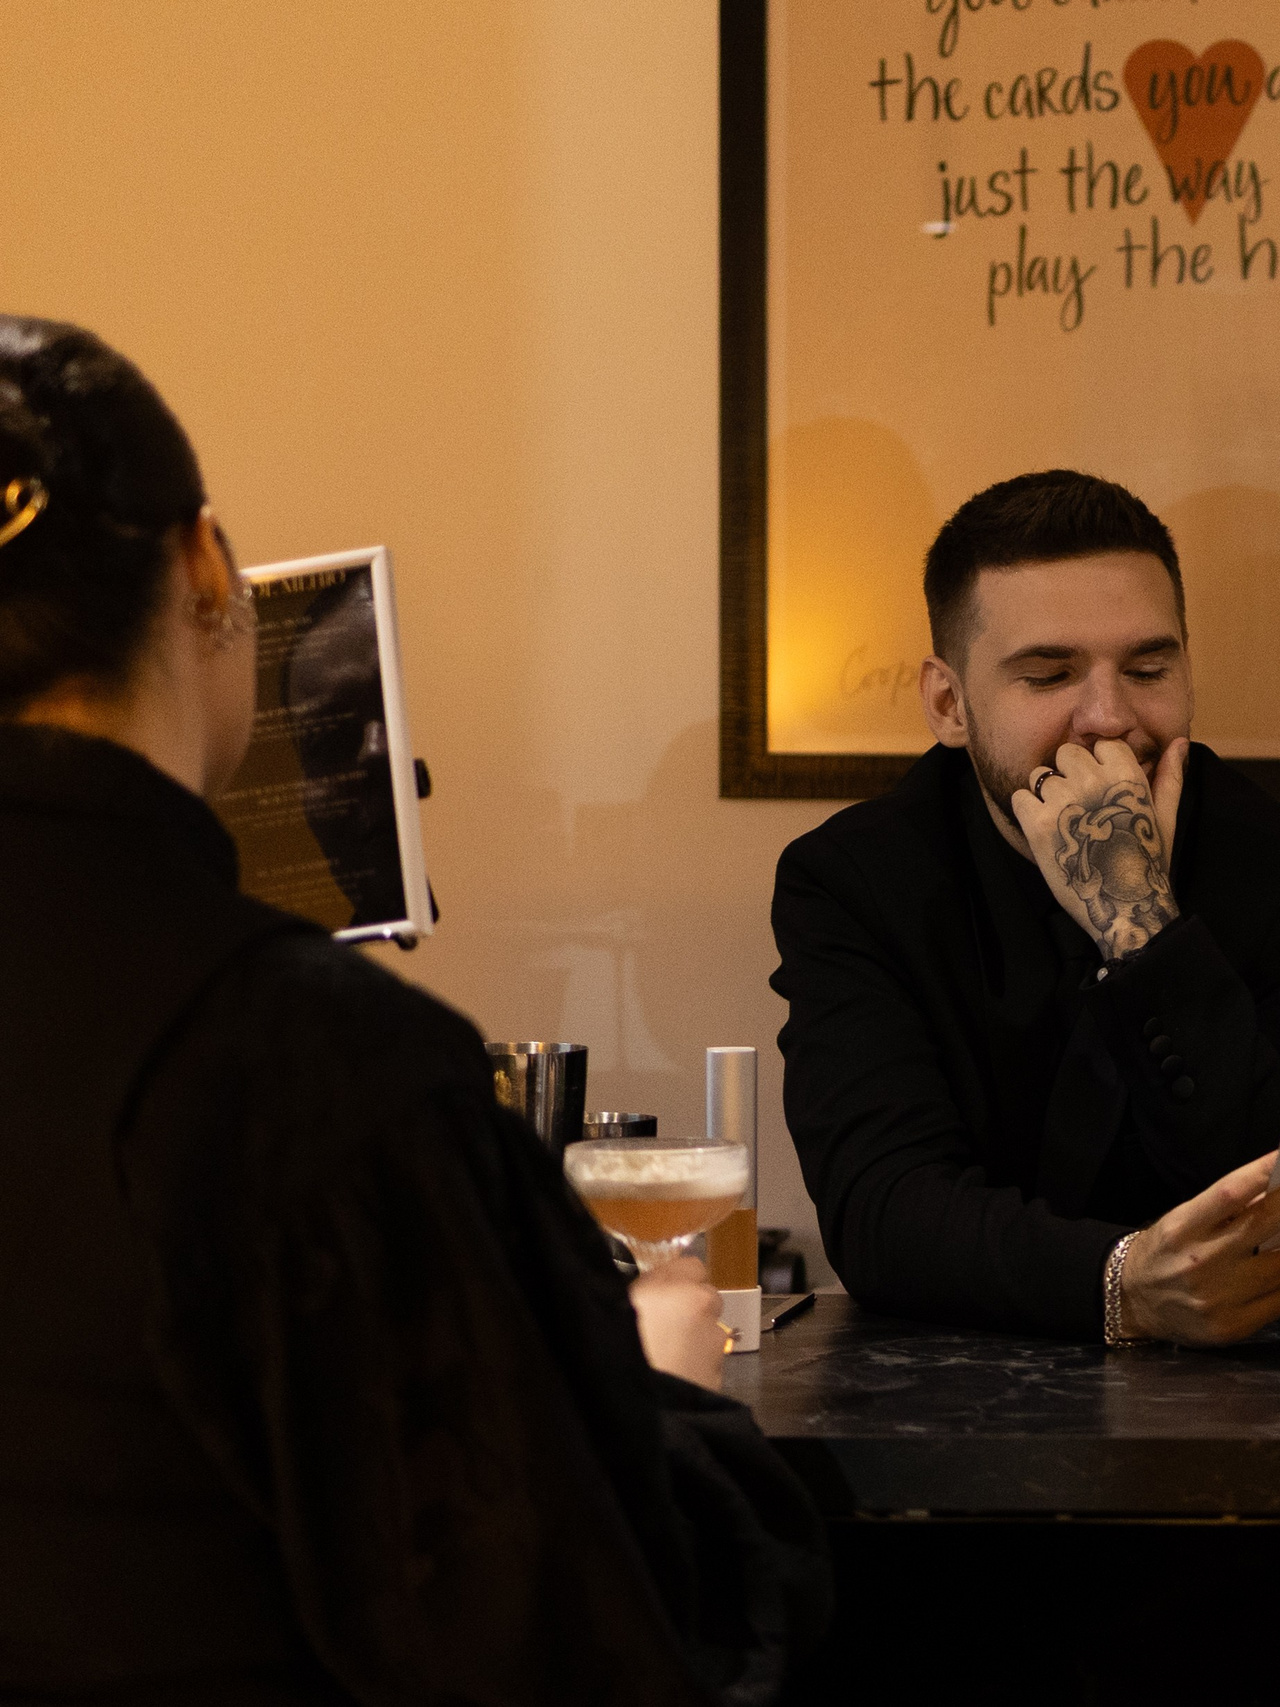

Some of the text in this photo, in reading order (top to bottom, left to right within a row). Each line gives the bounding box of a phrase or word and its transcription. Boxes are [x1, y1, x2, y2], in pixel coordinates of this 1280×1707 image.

[868, 54, 968, 122] the
[1146, 60, 1254, 143] you
[934, 147, 1038, 238] just
[1059, 142, 1149, 214] the
[1165, 155, 1268, 223] way
[986, 224, 1096, 332] play
[1115, 217, 1214, 289] the
